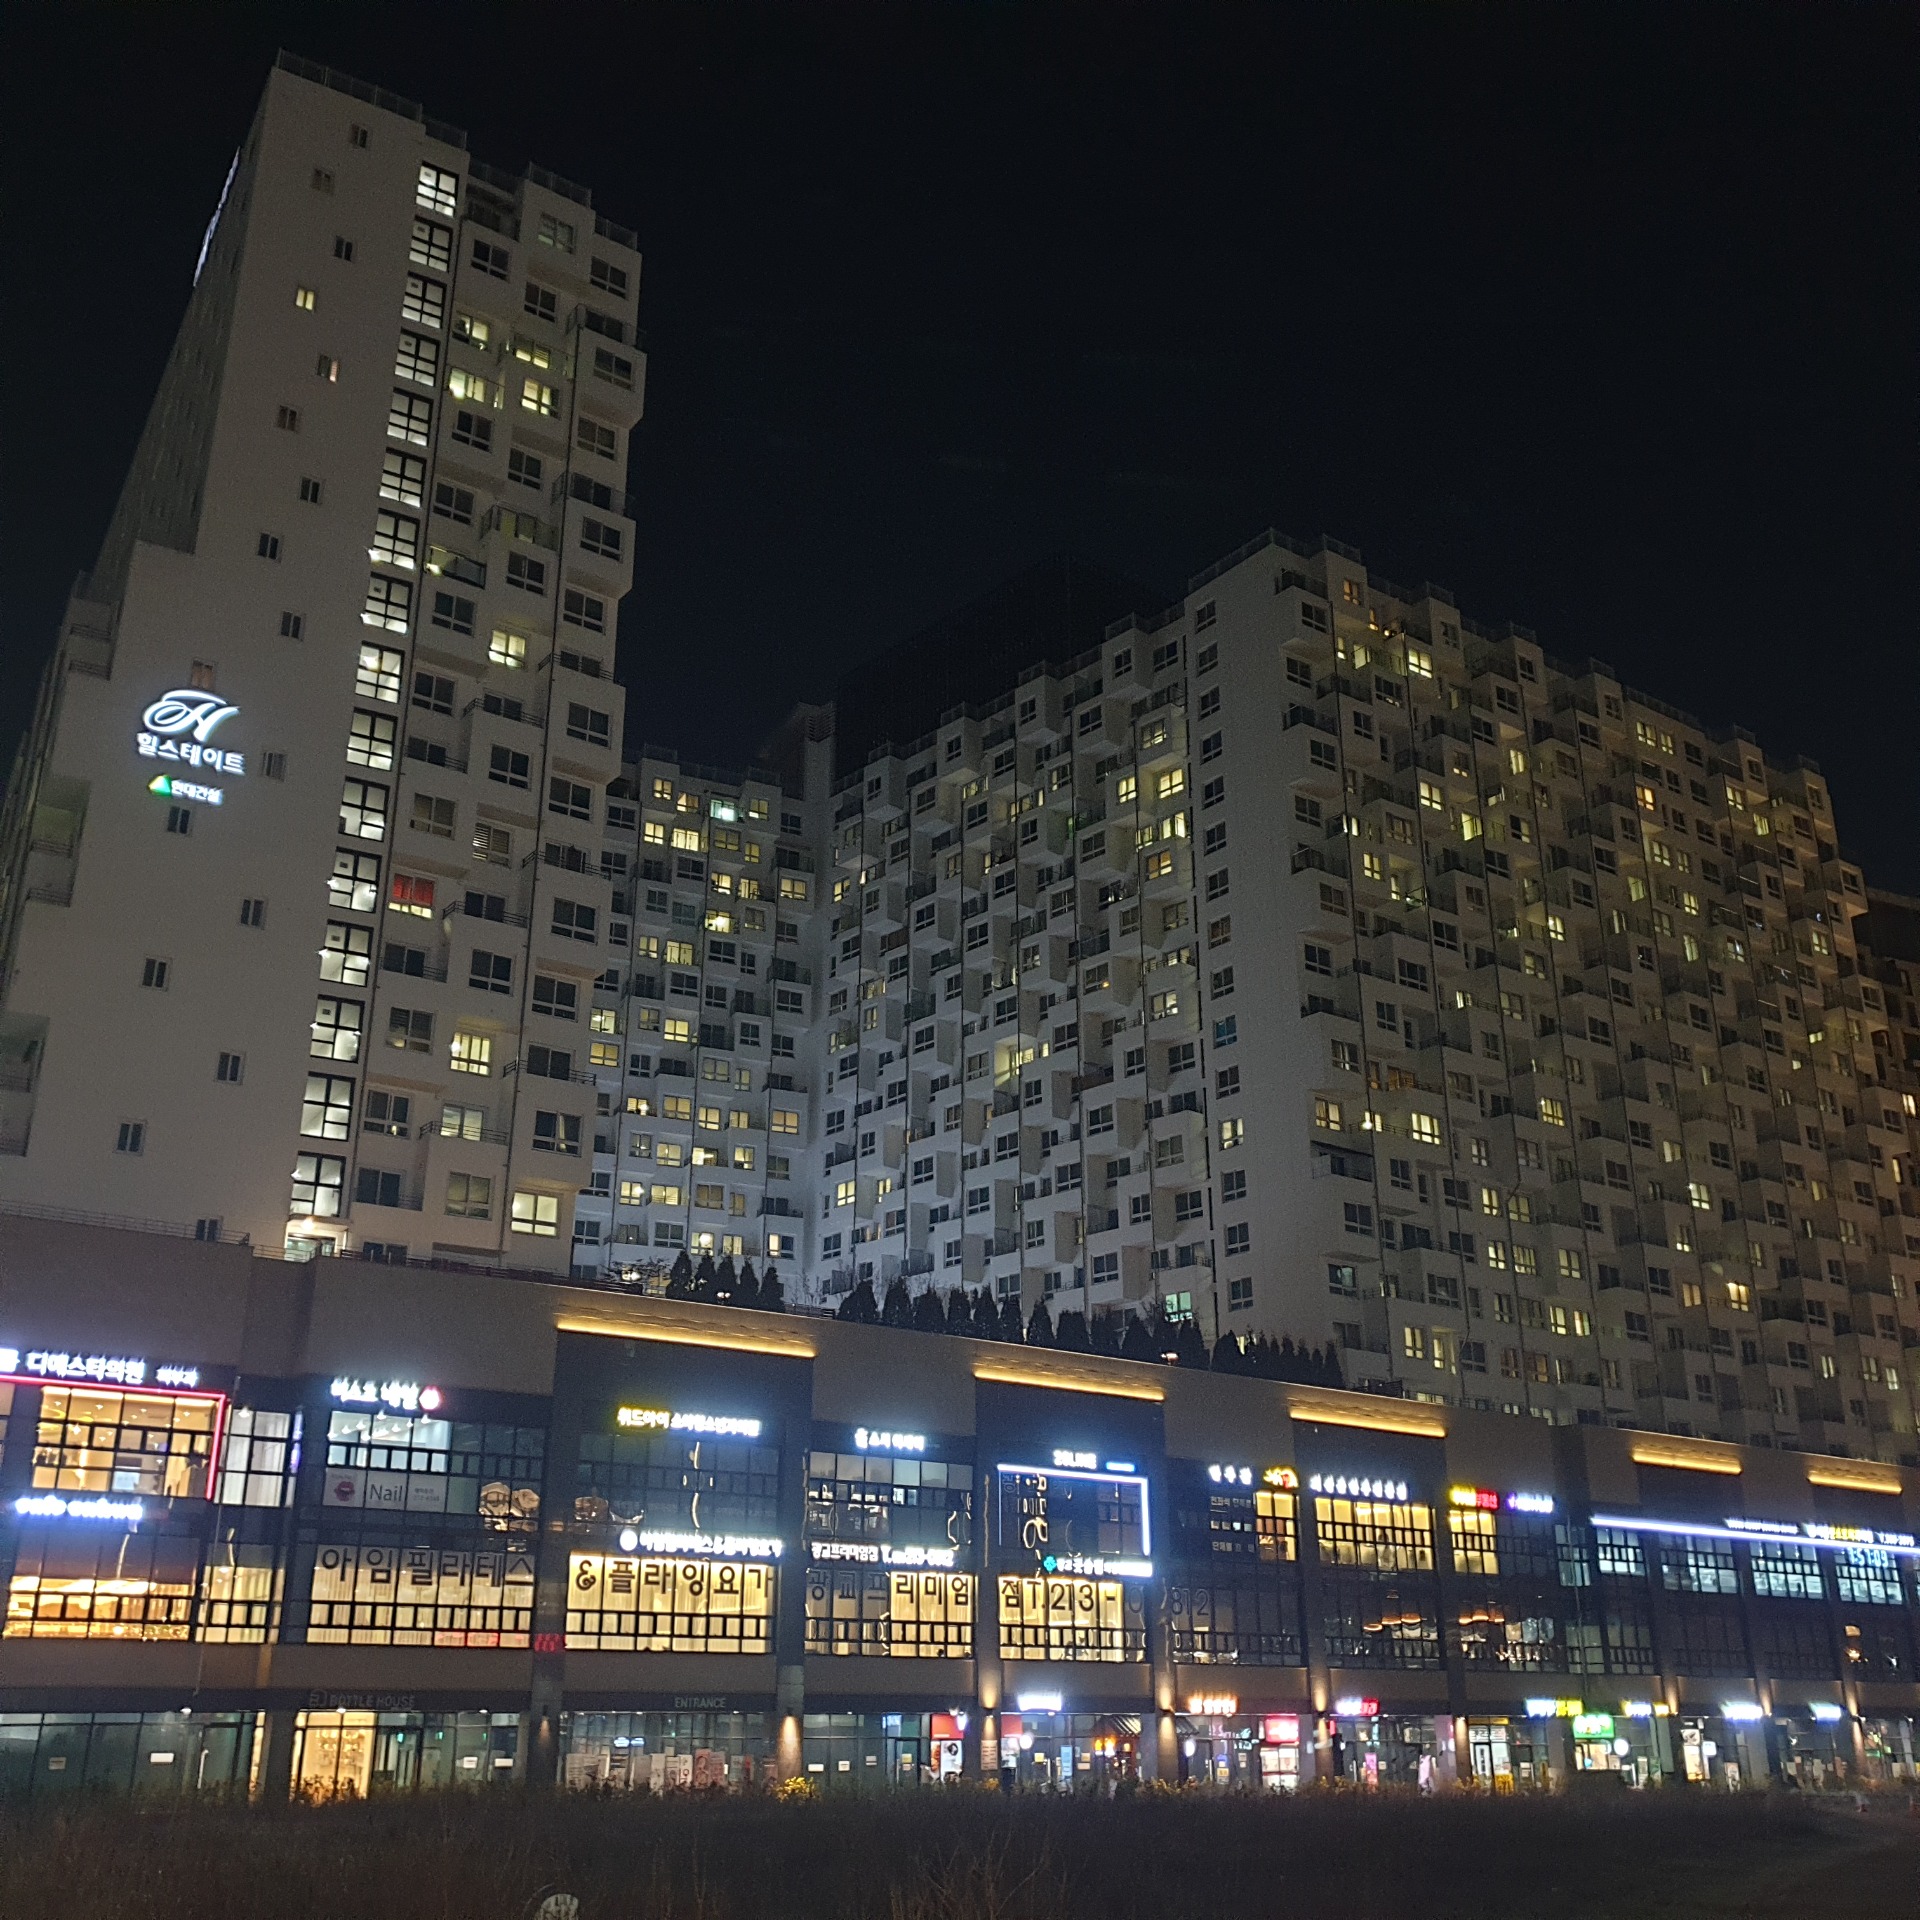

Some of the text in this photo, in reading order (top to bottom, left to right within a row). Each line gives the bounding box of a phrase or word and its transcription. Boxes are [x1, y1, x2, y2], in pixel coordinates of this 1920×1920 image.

[136, 731, 246, 776] 힐스테이트
[171, 779, 224, 806] 현대건설
[617, 1407, 670, 1429] 위드아이
[369, 1483, 403, 1502] Nail
[811, 1542, 879, 1563] 광교프리미엄점
[320, 1548, 534, 1588] 아임필라테스
[808, 1570, 970, 1607] 광교프리미엄
[675, 1696, 726, 1710] ENTRANCE
